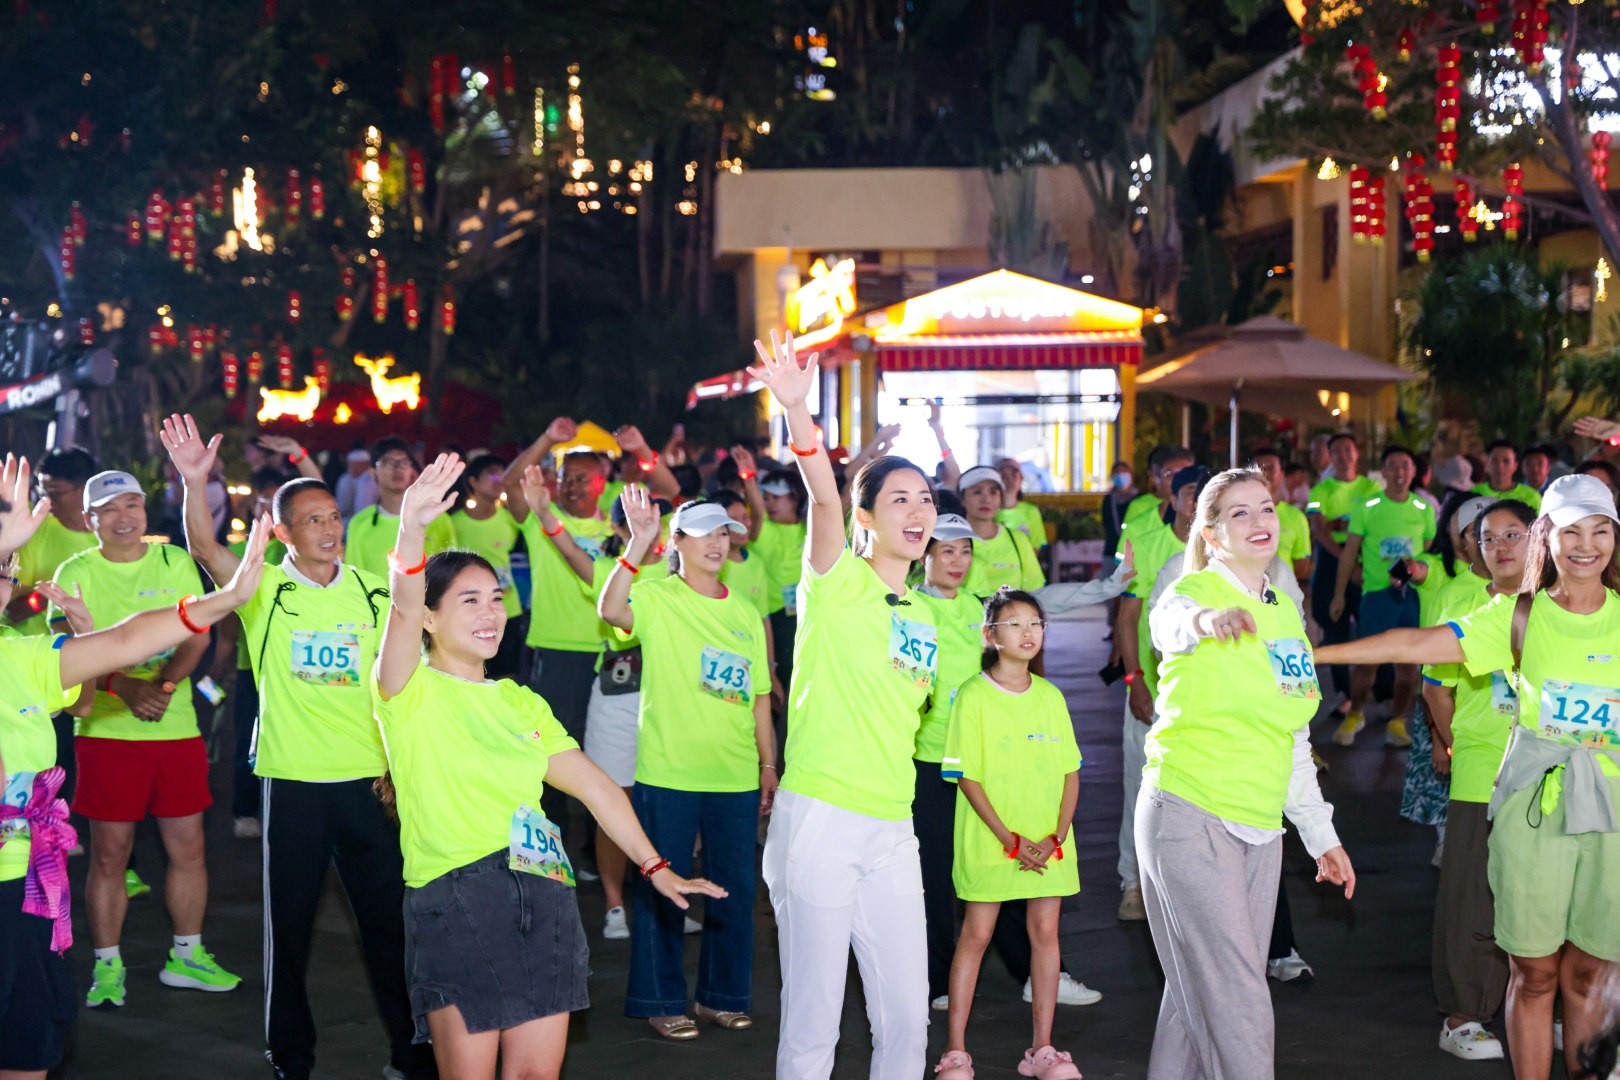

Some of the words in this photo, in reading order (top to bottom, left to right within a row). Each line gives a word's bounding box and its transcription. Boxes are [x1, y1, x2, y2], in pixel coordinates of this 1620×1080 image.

[7, 373, 61, 410] RONIN
[302, 645, 350, 668] 105
[899, 630, 937, 667] 267
[706, 661, 745, 688] 143
[1274, 653, 1313, 678] 266
[1552, 697, 1611, 727] 124
[521, 823, 561, 860] 194
